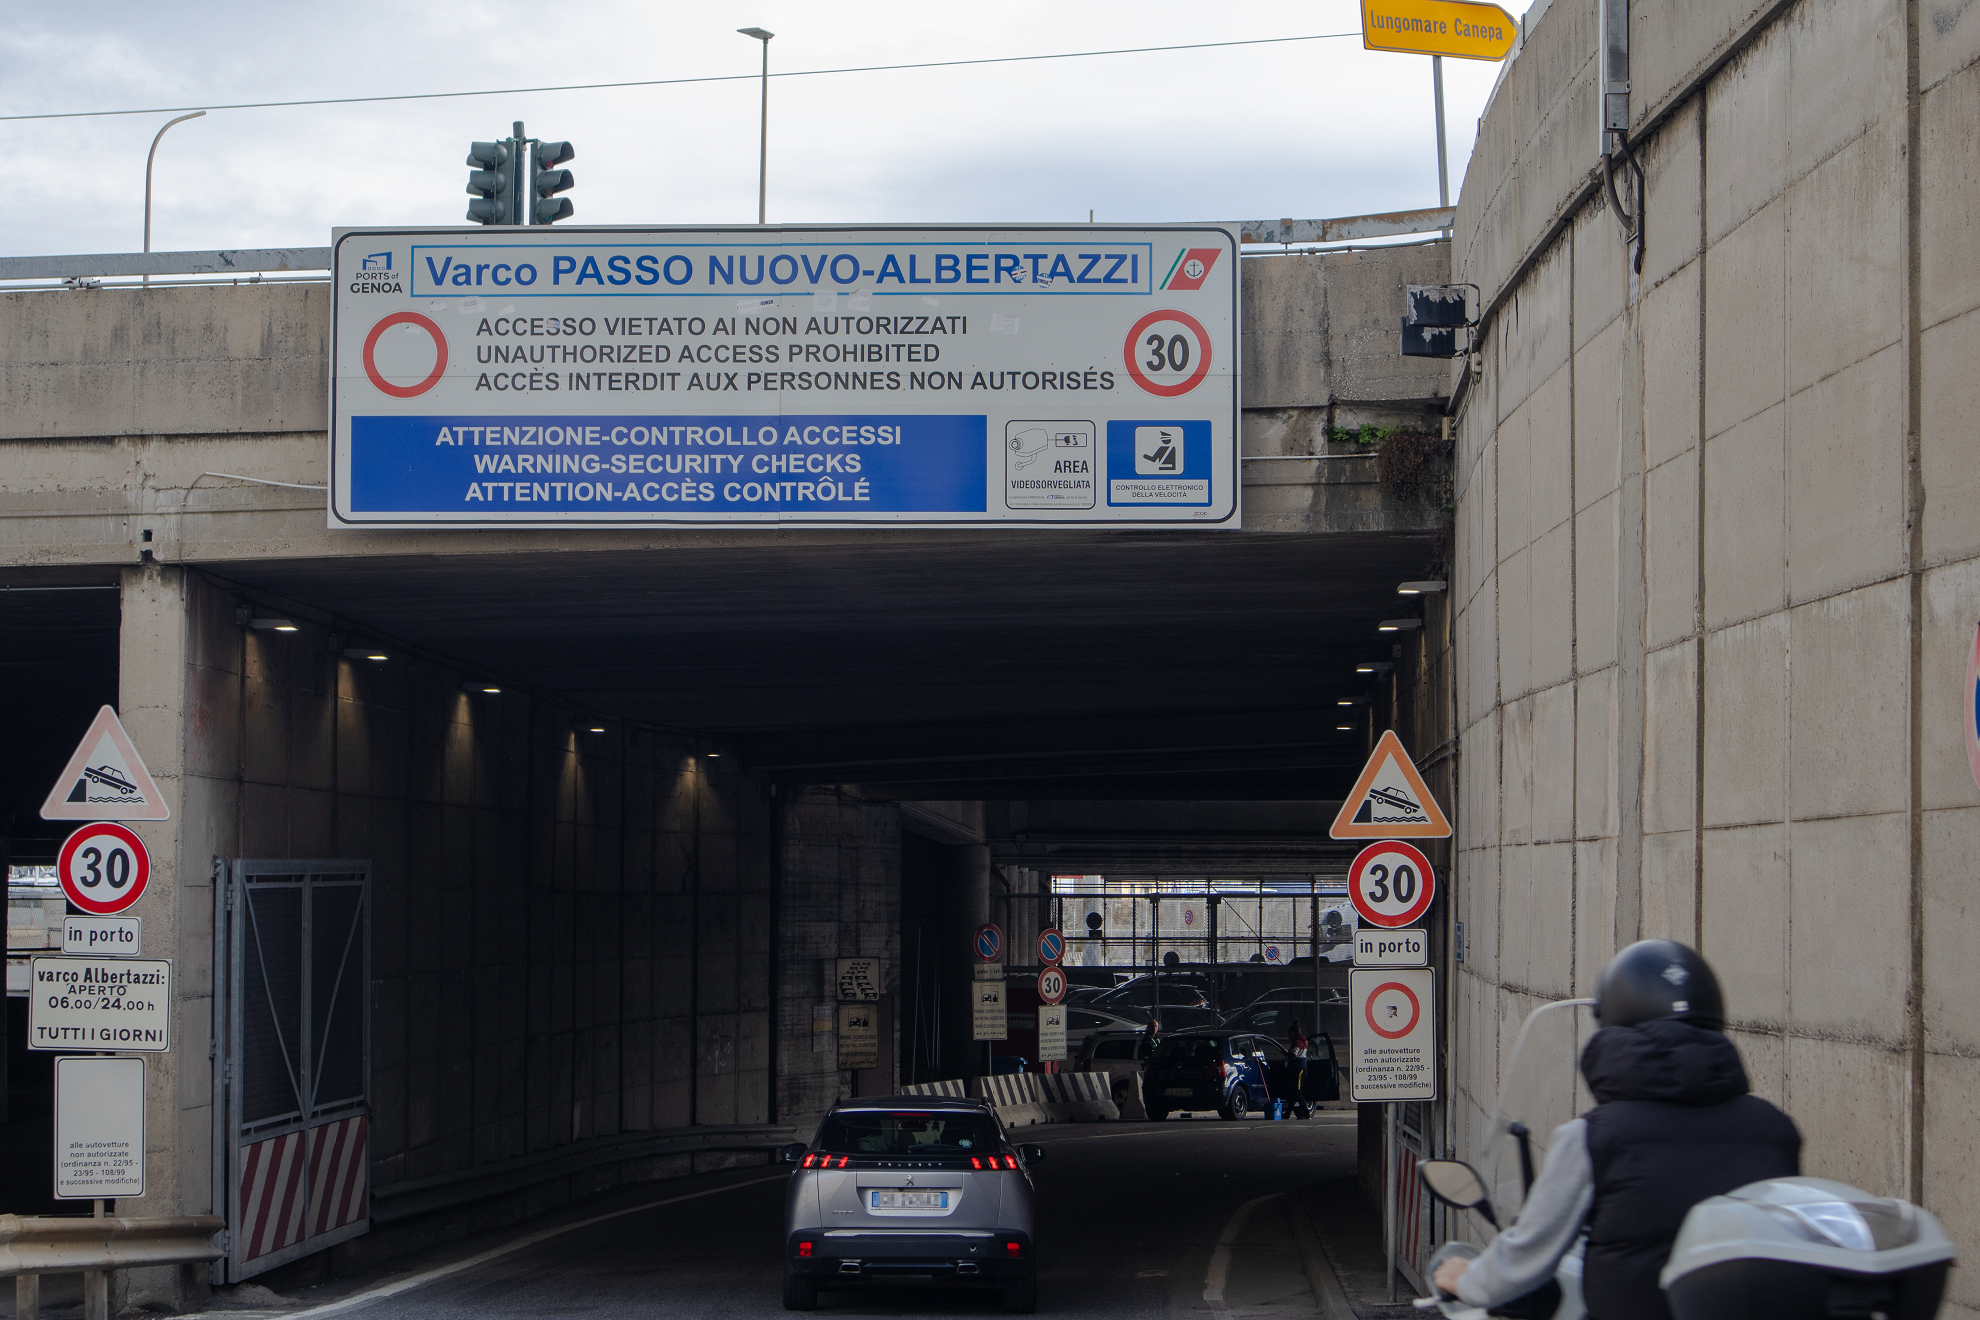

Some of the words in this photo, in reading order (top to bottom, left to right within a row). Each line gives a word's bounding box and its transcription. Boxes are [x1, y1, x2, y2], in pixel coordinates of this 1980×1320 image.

[1454, 17, 1503, 42] Canepa
[355, 272, 390, 281] PORTS
[391, 272, 400, 280] of
[425, 255, 538, 287] Varco
[552, 255, 694, 287] PASSO
[708, 253, 1139, 287] NUOVO-ALBERTAZZI
[349, 282, 403, 294] GENOA
[475, 317, 597, 337] ACCESSO
[603, 316, 706, 336] VIETATO
[712, 316, 736, 336] AI
[744, 316, 798, 336] NON
[804, 315, 968, 336] AUTORIZZATI
[476, 344, 672, 364] UNAUTHORIZED
[678, 344, 780, 364] ACCESS
[788, 343, 940, 363] PROHIBITED
[1145, 333, 1190, 373] 30
[475, 366, 560, 392] ACCÈS
[568, 371, 682, 391] INTERDIT
[687, 371, 738, 391] AUX
[747, 371, 901, 391] PERSONNES
[909, 371, 964, 390] NON
[970, 366, 1115, 390] AUTORISÉS
[435, 426, 779, 447] ATTENZIONE-CONTROLLO
[783, 425, 902, 446] ACCESSI
[473, 453, 745, 475] WARNING-SECURITY
[751, 453, 862, 474] CHECKS
[1053, 460, 1090, 474] AREA
[465, 478, 715, 502] ATTENTION-ACCÈS
[722, 476, 871, 502] CONTRÔLÉ
[1011, 479, 1091, 489] VIDEOSORVEGLIATA
[1155, 490, 1188, 498] VELOCITÀ
[80, 846, 130, 889] 30
[1368, 863, 1416, 904] 30
[68, 926, 83, 942] in
[89, 926, 134, 947] porto
[1359, 938, 1374, 954] in
[1378, 937, 1421, 958] porto
[37, 968, 79, 984] varco
[83, 967, 166, 986] Albertazzi:
[67, 985, 127, 996] APERTO
[1044, 976, 1060, 994] 30
[148, 1001, 155, 1011] h
[37, 1026, 86, 1040] TUTTI
[91, 1028, 95, 1041] I
[100, 1028, 163, 1043] GIORNI
[1378, 1047, 1421, 1055] autovetture
[1355, 1066, 1395, 1074] (ordinanza
[1405, 1064, 1425, 1072] 22/95
[1367, 1074, 1388, 1082] 23/95
[1394, 1073, 1418, 1081] 108/99
[1397, 1081, 1432, 1090] modifiche)
[85, 1141, 130, 1149] autovetture
[86, 1150, 129, 1158] autorizzate
[61, 1160, 102, 1169] (ordinanza
[113, 1159, 134, 1167] 22/95
[73, 1169, 94, 1177] 23/95
[101, 1168, 126, 1176] 108/99
[66, 1178, 103, 1186] successive
[104, 1177, 141, 1186] modifiche)
